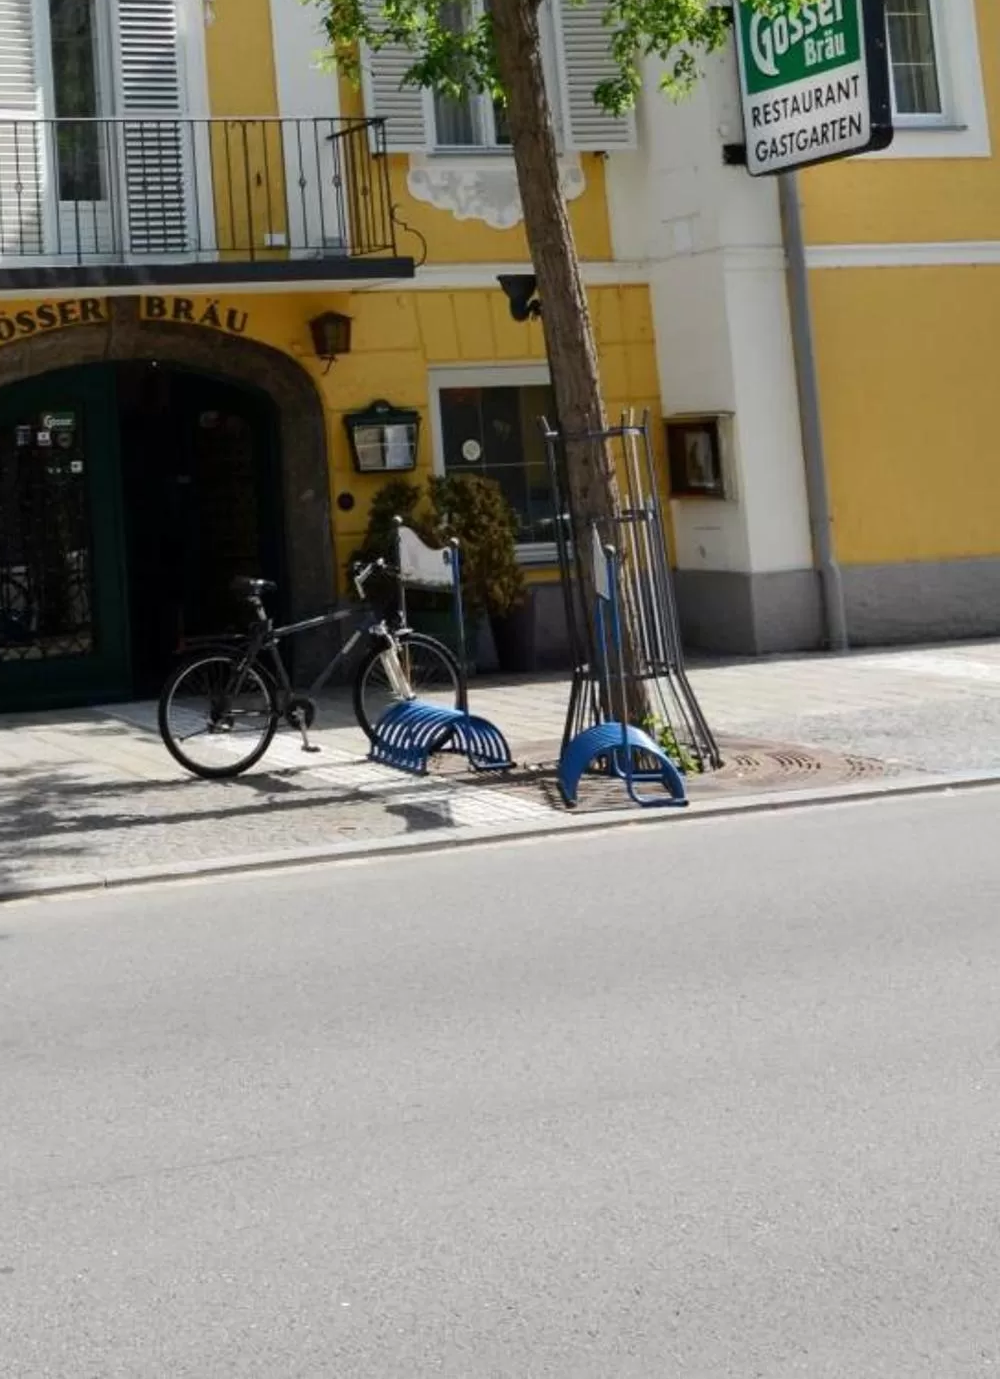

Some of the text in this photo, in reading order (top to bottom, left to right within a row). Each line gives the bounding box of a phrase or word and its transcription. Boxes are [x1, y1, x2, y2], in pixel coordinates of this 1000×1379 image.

[804, 28, 845, 66] Bräu
[751, 75, 860, 127] RESTAURANT
[755, 113, 862, 162] GASTGARTEN
[145, 296, 249, 334] BRÄU
